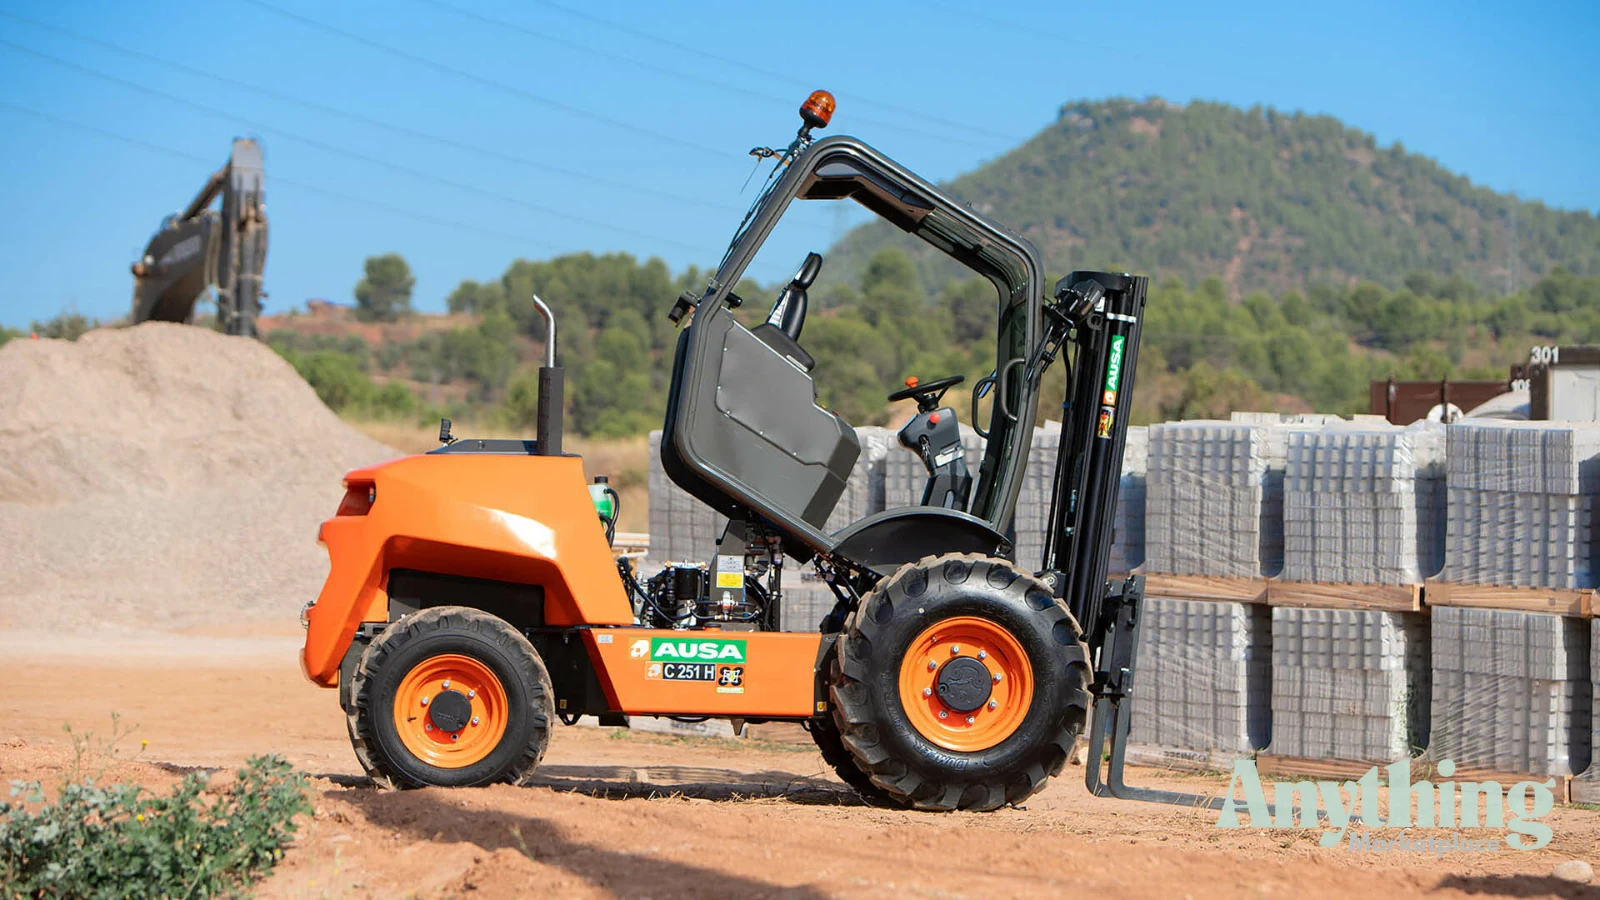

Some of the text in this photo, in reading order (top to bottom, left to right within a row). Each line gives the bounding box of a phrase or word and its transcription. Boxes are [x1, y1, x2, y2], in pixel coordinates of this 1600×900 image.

[1531, 346, 1559, 364] 301
[1108, 339, 1122, 389] AUSA
[654, 642, 743, 659] AUSA
[664, 664, 715, 680] C 251 H
